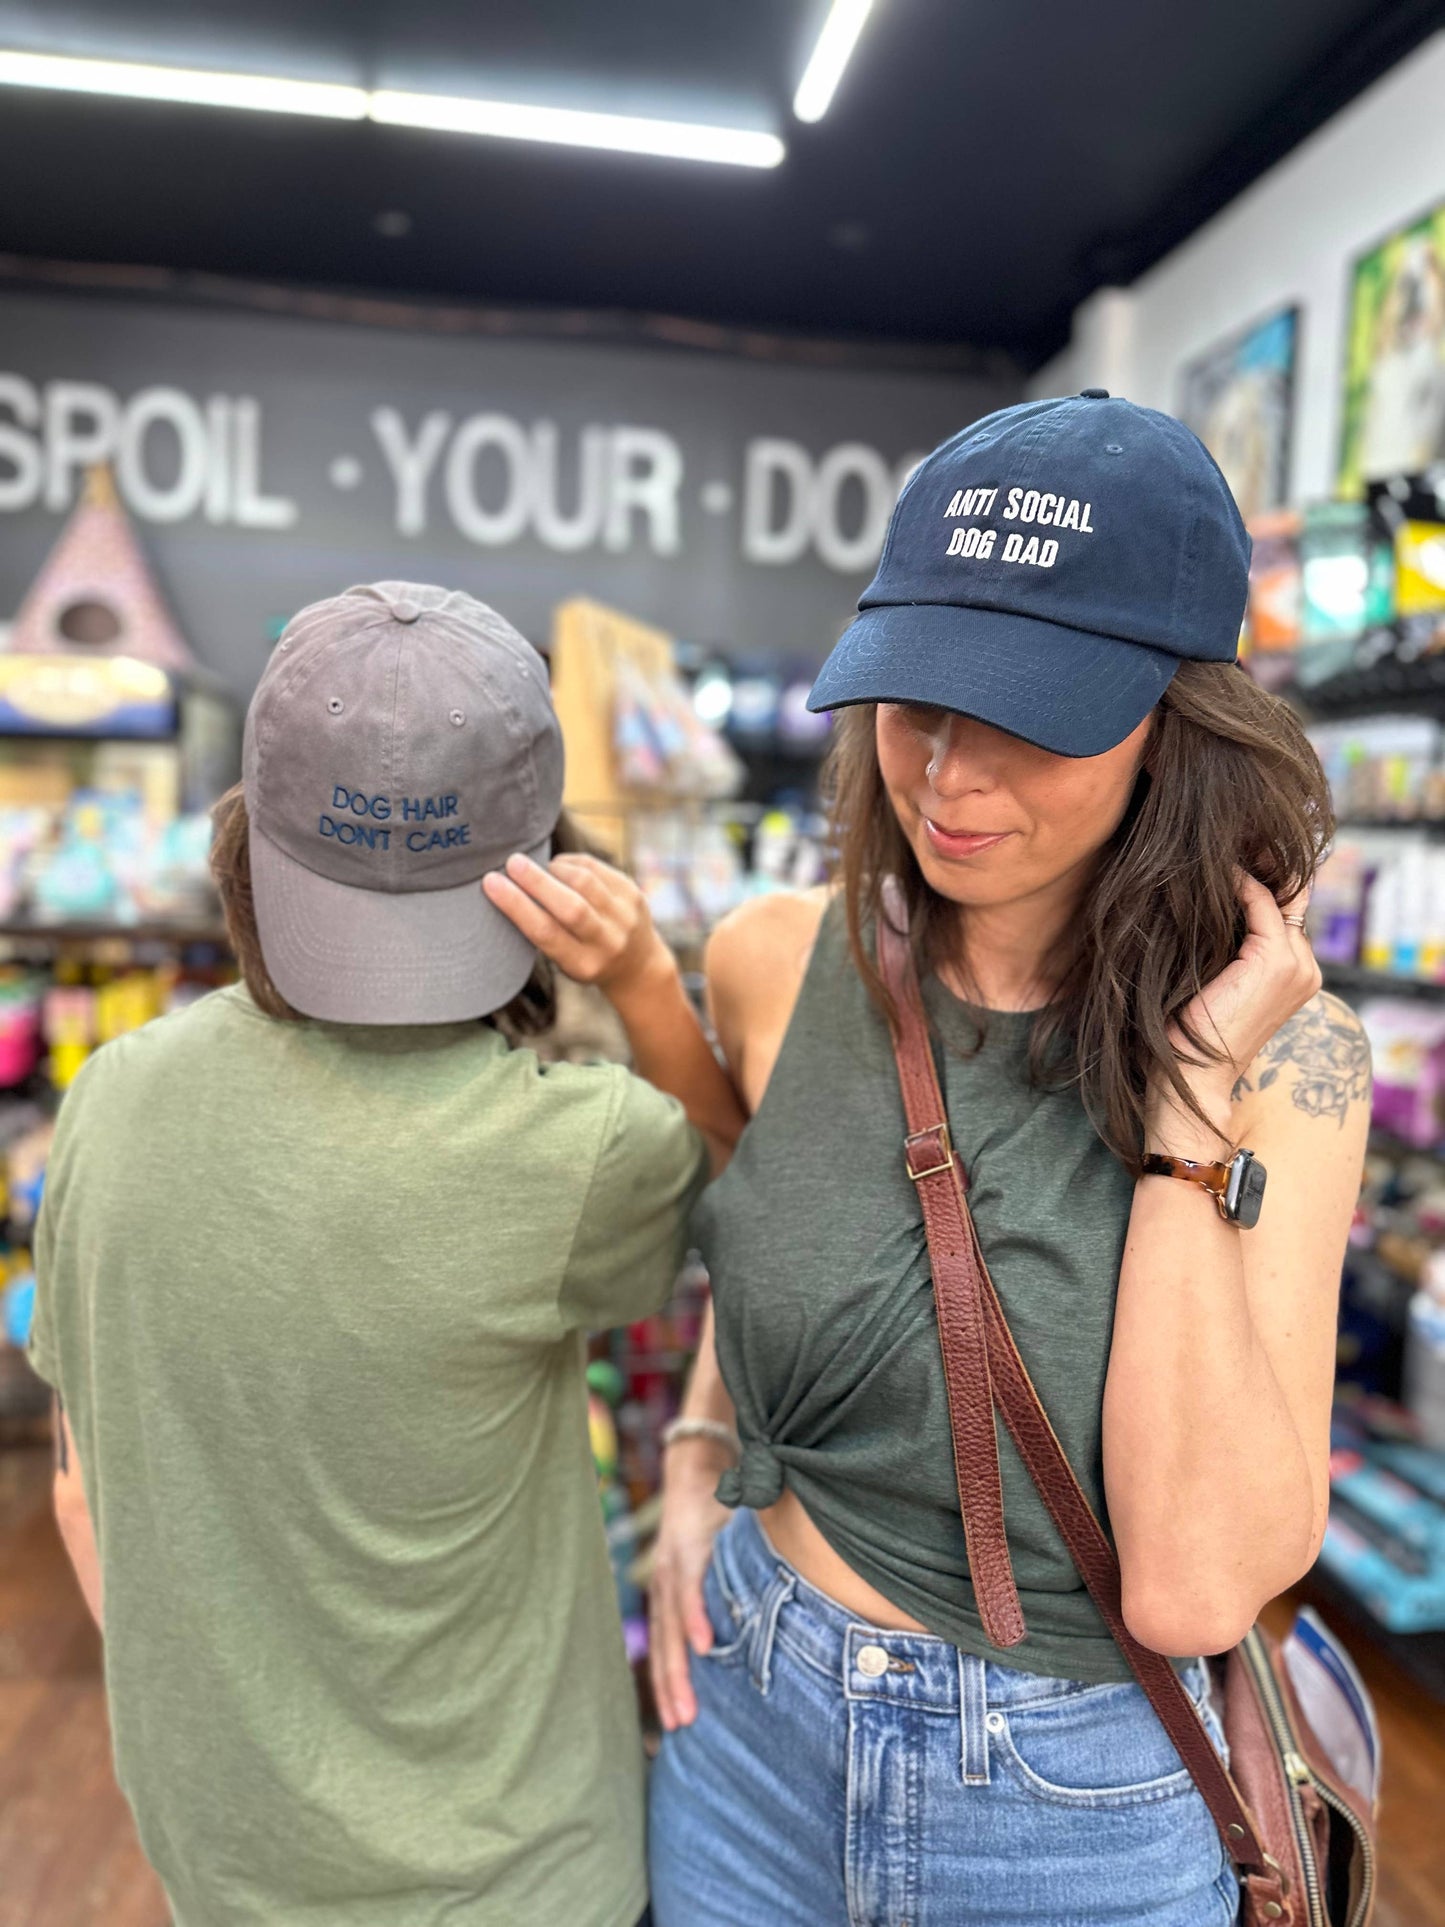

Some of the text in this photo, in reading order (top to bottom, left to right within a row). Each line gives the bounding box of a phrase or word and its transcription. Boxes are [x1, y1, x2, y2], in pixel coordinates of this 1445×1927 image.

[0, 372, 922, 573] SPOIL YOUR DO
[943, 487, 1094, 533] ANTI SOCIAL
[946, 527, 1060, 568] DOG DAD
[332, 785, 460, 821] DOG HAIR
[319, 814, 472, 852] DONT CARE
